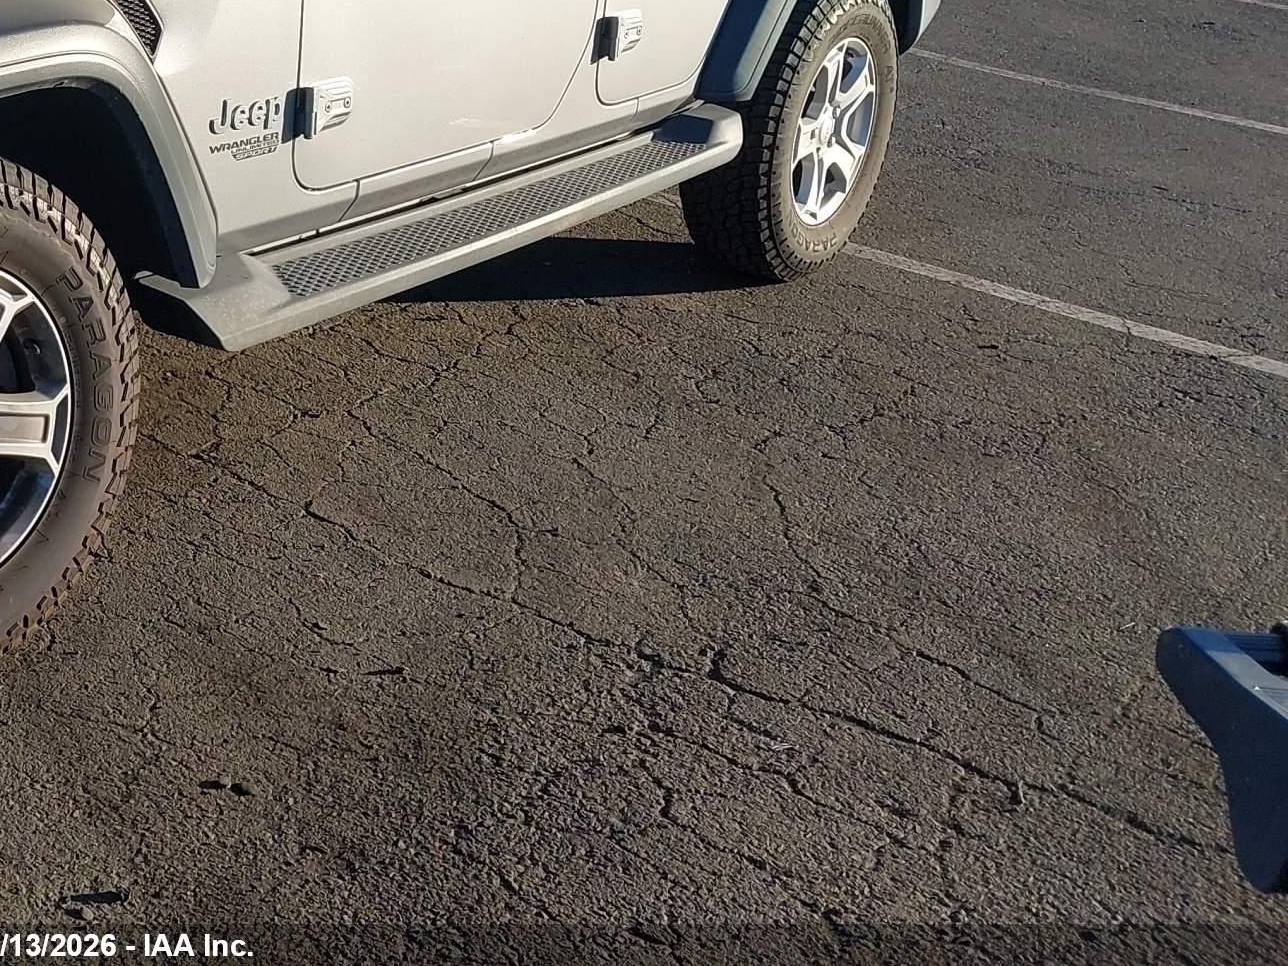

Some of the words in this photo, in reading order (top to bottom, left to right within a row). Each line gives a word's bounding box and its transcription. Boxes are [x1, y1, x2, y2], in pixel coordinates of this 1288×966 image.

[209, 96, 281, 135] Jeep
[209, 132, 279, 154] WRANGLER
[231, 140, 280, 153] UNLIMITED
[56, 265, 114, 483] PARAGON
